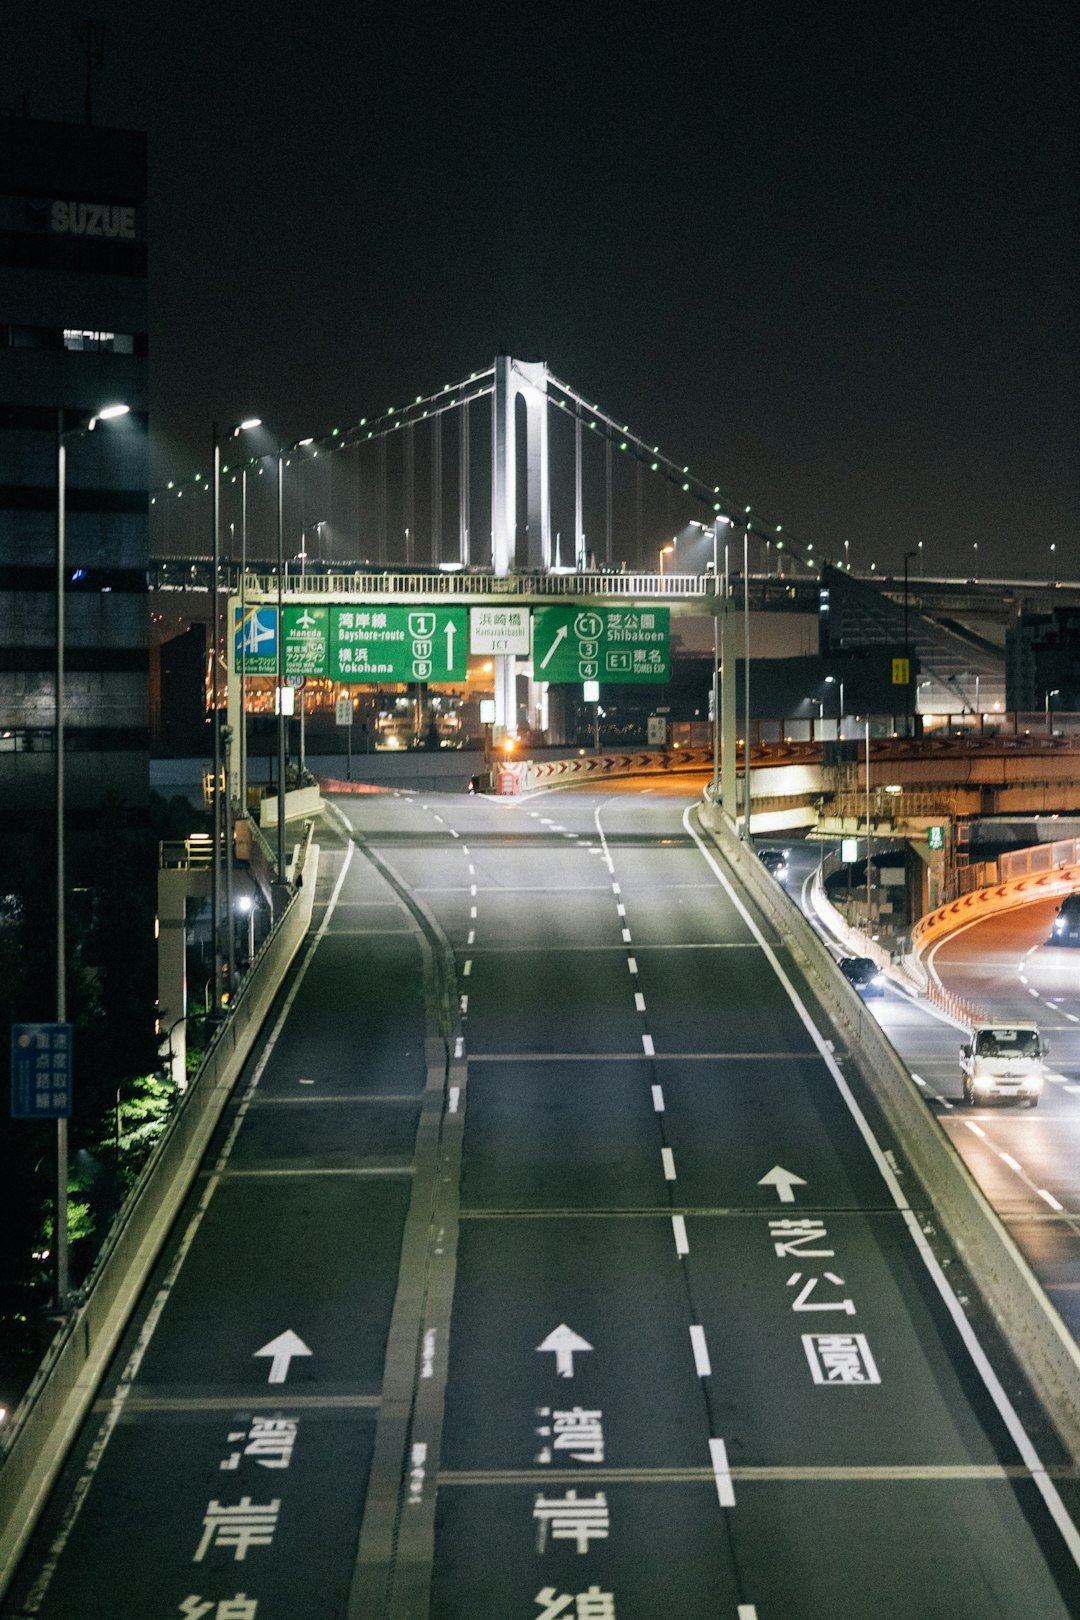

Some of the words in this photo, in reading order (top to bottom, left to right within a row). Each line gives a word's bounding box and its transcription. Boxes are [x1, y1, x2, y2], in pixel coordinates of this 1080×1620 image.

[50, 200, 136, 238] SUZUE
[338, 612, 387, 628] 湾岸線
[417, 617, 428, 633] 1
[479, 613, 521, 626] 浜崎橋
[607, 613, 655, 629] 芝公園
[290, 628, 322, 637] Haneda
[475, 626, 525, 636] Hamazakibashi
[579, 619, 596, 635] C1
[338, 629, 405, 642] Bayshore-route
[607, 629, 664, 641] Shibakoen
[311, 642, 323, 651] CA
[416, 643, 427, 656] 11
[492, 639, 509, 650] JCT
[585, 643, 593, 656] 3
[338, 648, 368, 662] 横浜
[611, 655, 627, 668] E1
[633, 649, 661, 663] 東名
[338, 662, 394, 673] Yokohama
[419, 663, 427, 675] B
[584, 663, 592, 676] 4
[633, 663, 652, 674] TOMEI
[653, 664, 666, 673] EXP
[52, 1033, 67, 1109] 速度取締
[768, 1219, 882, 1385] 芝公園
